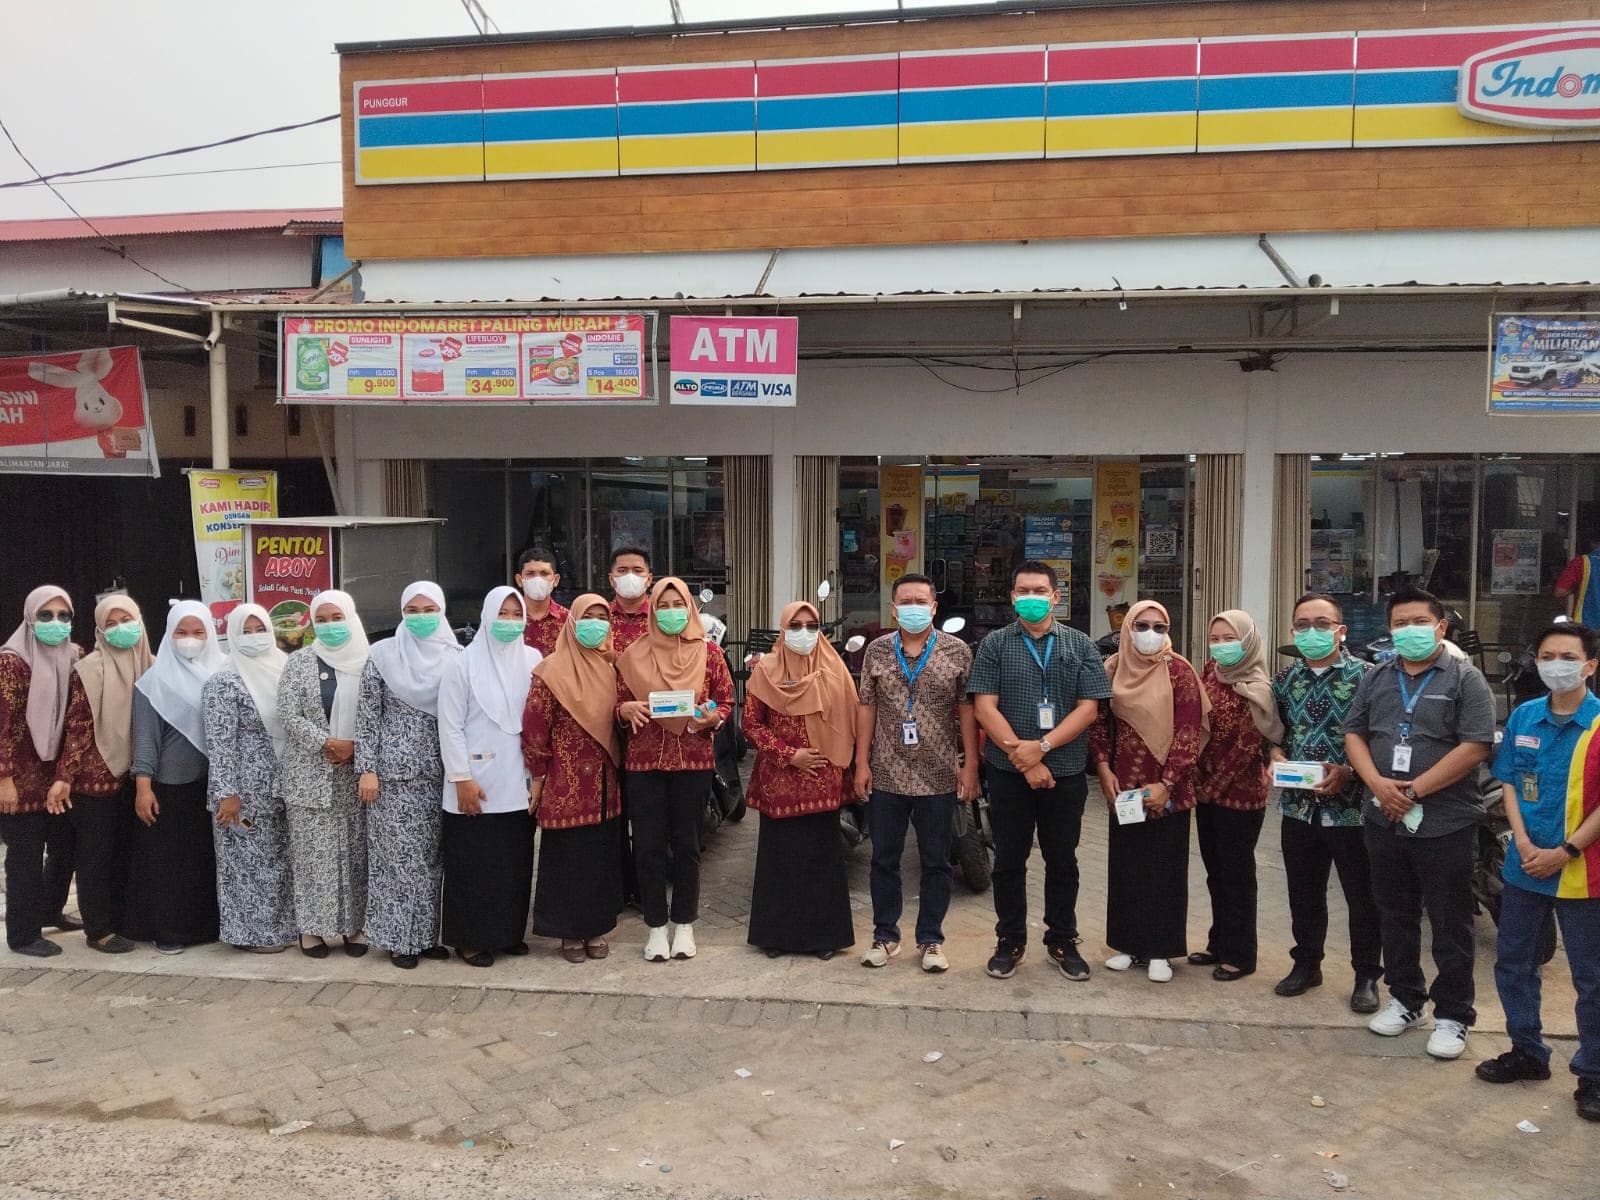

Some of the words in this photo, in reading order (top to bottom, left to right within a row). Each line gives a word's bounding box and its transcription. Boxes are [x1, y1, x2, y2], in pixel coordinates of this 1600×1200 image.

[363, 97, 408, 108] PUNGGUR
[314, 319, 375, 333] PROMO
[378, 319, 477, 333] INDOMARET
[481, 318, 543, 332] PALING
[546, 316, 610, 331] MURAH
[351, 336, 389, 344] SUNLIGHT
[467, 335, 504, 343] LIFEBUOY
[587, 333, 622, 341] INDOMIE
[689, 327, 777, 363] ATM
[1534, 339, 1600, 351] MILIARAN
[364, 378, 396, 393] 9.900
[471, 378, 515, 394] 34.900
[595, 377, 638, 393] 14.400
[675, 382, 698, 392] ALTO
[732, 381, 757, 391] ATM
[761, 383, 792, 396] VISA
[0, 390, 38, 405] SINI
[200, 500, 232, 515] KAMI
[235, 500, 271, 512] HADIR
[206, 522, 243, 534] KONSE
[256, 536, 325, 555] PENTOL
[264, 556, 317, 578] ABOY
